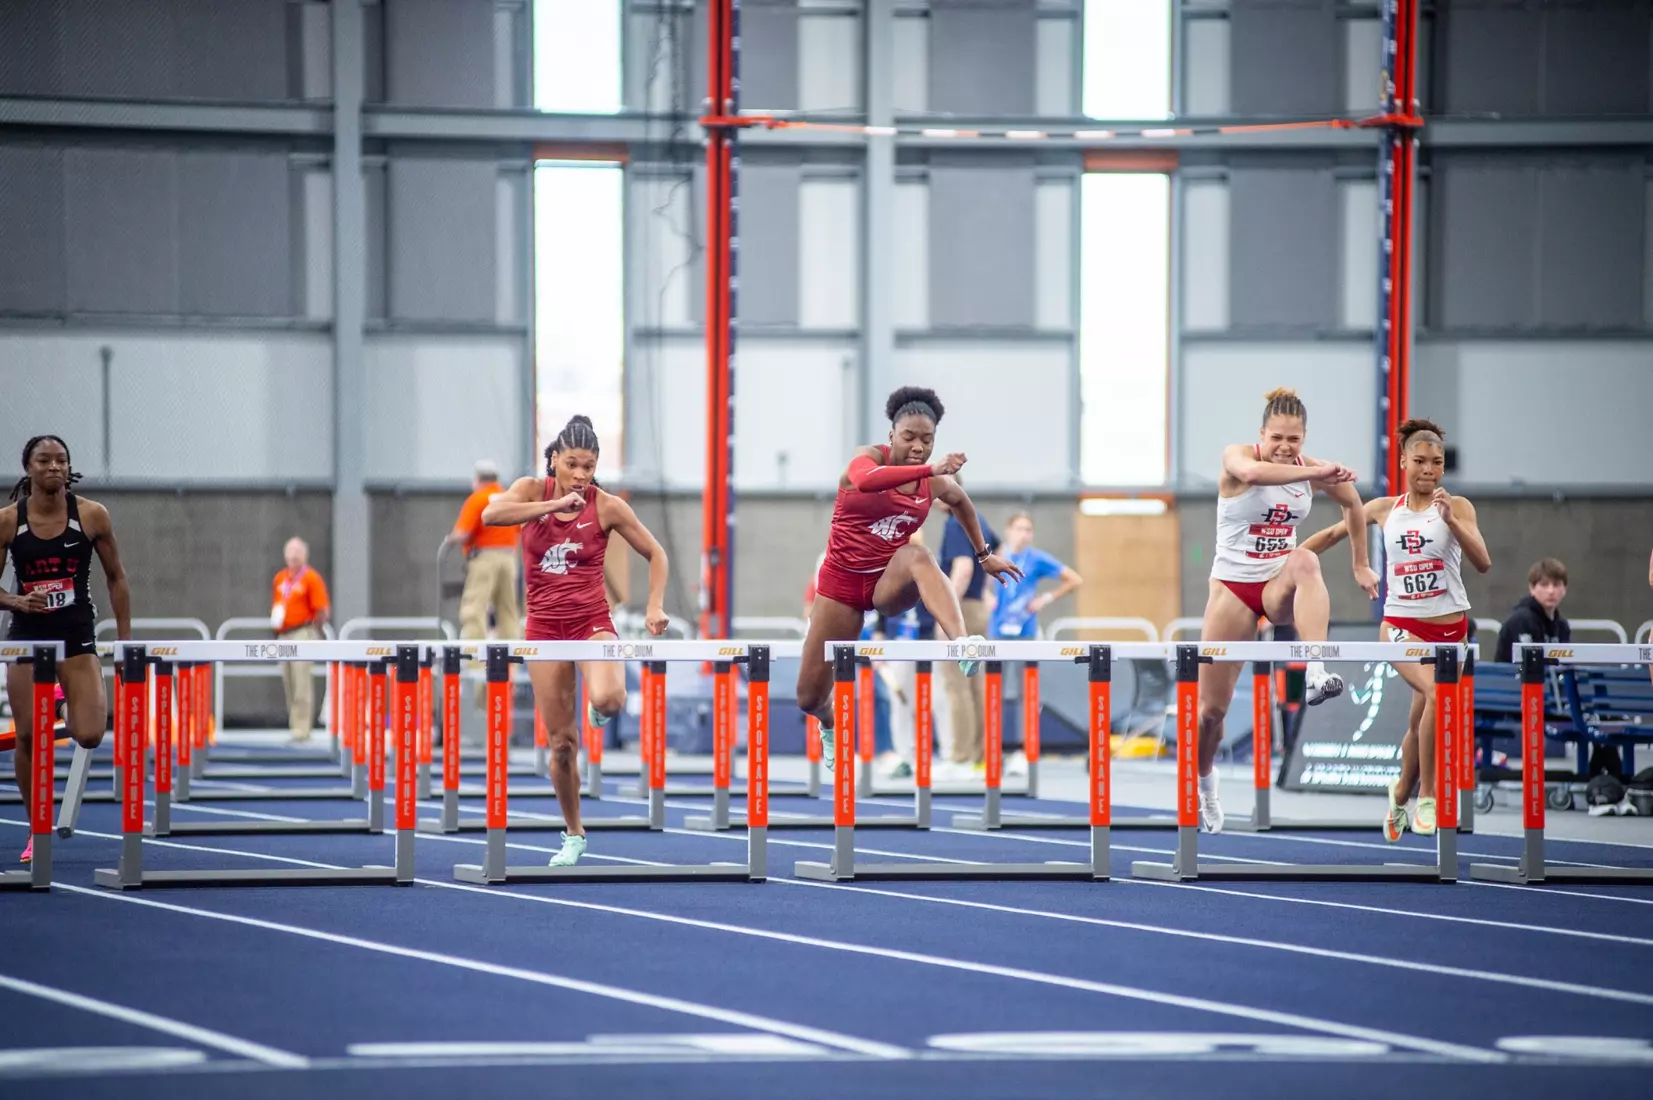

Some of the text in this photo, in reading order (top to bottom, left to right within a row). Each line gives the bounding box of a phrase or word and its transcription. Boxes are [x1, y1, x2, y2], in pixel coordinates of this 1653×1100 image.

[1403, 573, 1439, 594] 662
[48, 592, 66, 608] 18
[1392, 627, 1405, 642] 2
[151, 648, 178, 656] GILL
[244, 645, 259, 657] THE
[366, 648, 391, 656] GILL
[513, 648, 538, 656] GILL
[603, 645, 618, 657] THE
[719, 648, 743, 656] GILL
[860, 648, 884, 656] GILL
[946, 645, 960, 657] THE
[1290, 645, 1303, 658] THE
[1405, 648, 1431, 656] GILL
[1548, 649, 1574, 657] GILL
[1638, 648, 1652, 660] THE
[403, 696, 411, 816] SPOKANE
[494, 696, 502, 816] SPOKANE
[1531, 697, 1539, 816] SPOKANE
